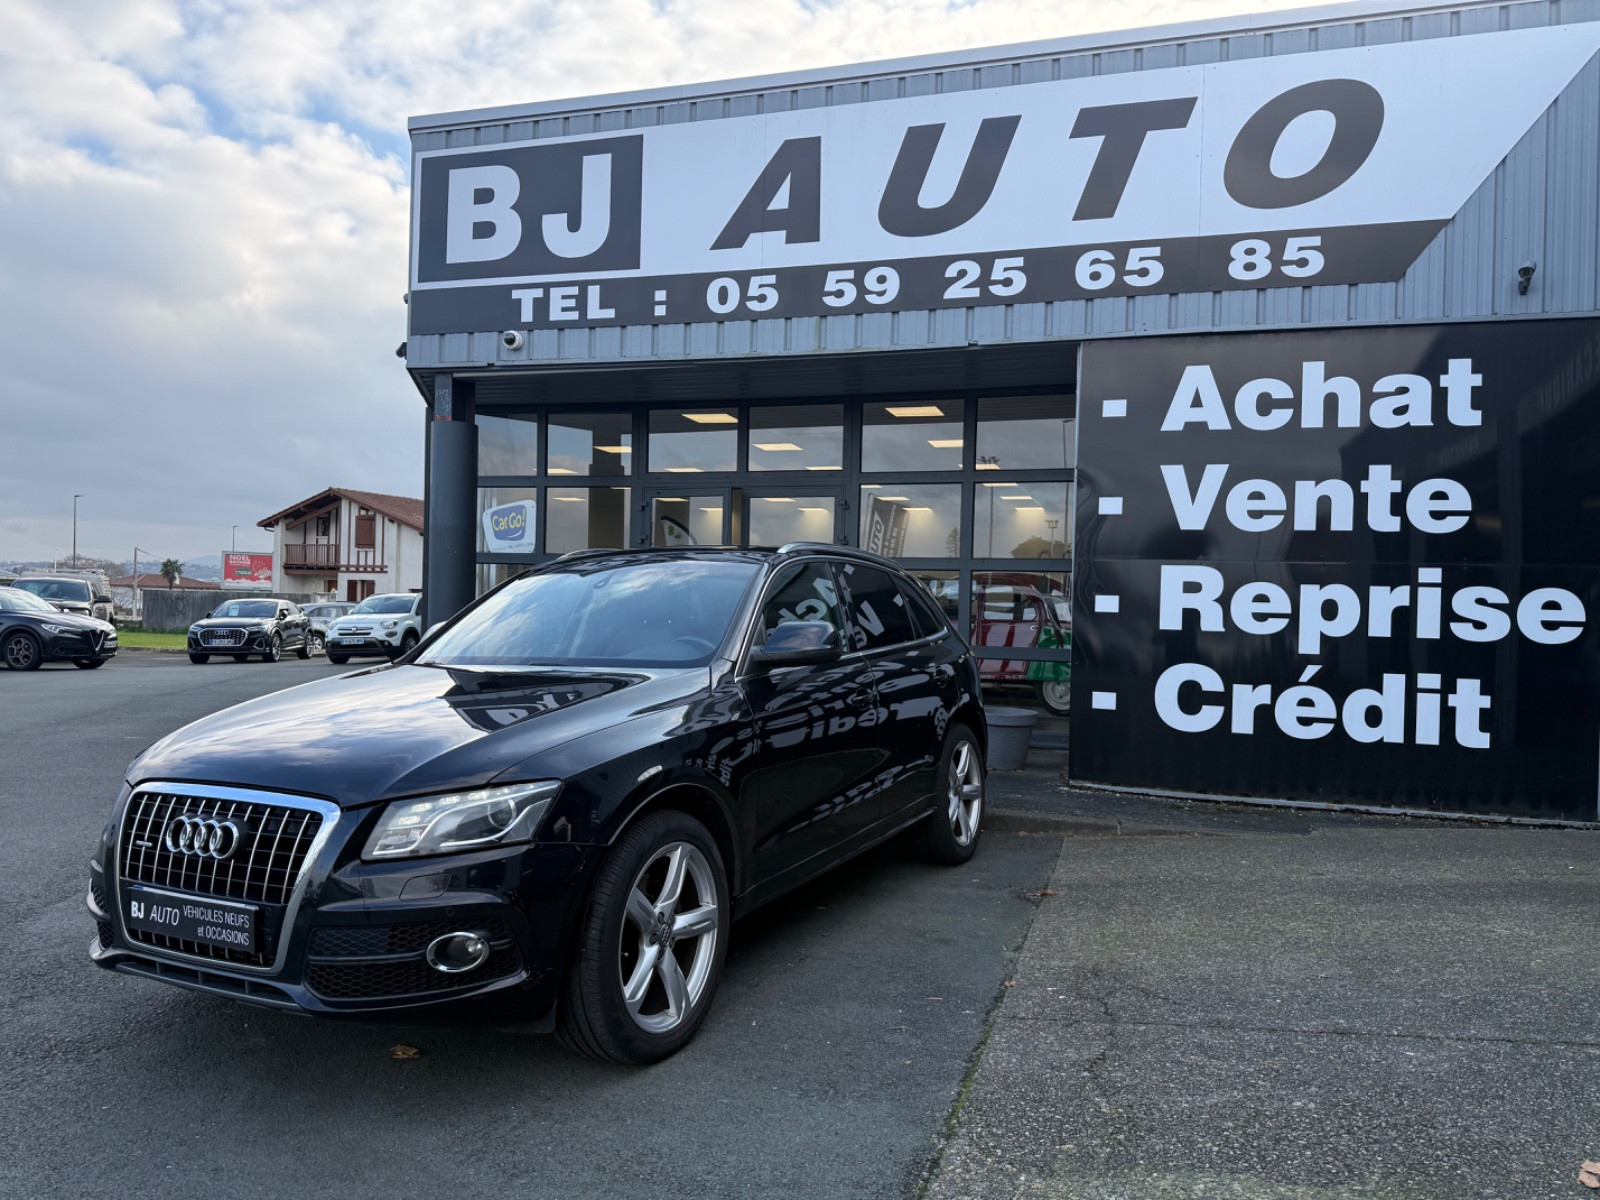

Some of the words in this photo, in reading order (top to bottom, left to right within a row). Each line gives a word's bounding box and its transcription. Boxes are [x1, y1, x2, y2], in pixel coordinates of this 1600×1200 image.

[446, 152, 614, 264] BJ
[709, 78, 1385, 250] AUTO
[511, 284, 616, 323] TEL
[706, 274, 779, 314] 05
[822, 265, 901, 307] 59
[943, 256, 1027, 299] 25
[1074, 245, 1165, 290] 65
[1227, 235, 1326, 280] 85
[1160, 358, 1483, 431] Achat
[1159, 463, 1473, 534] Vente
[1159, 564, 1587, 655] Reprise
[1154, 662, 1492, 749] Crédit
[131, 901, 145, 919] BJ
[149, 904, 180, 926] AUTO
[182, 904, 224, 924] VEHICULES
[224, 911, 250, 929] NEUFS
[197, 925, 205, 937] et
[205, 925, 250, 946] OCCASIONS
